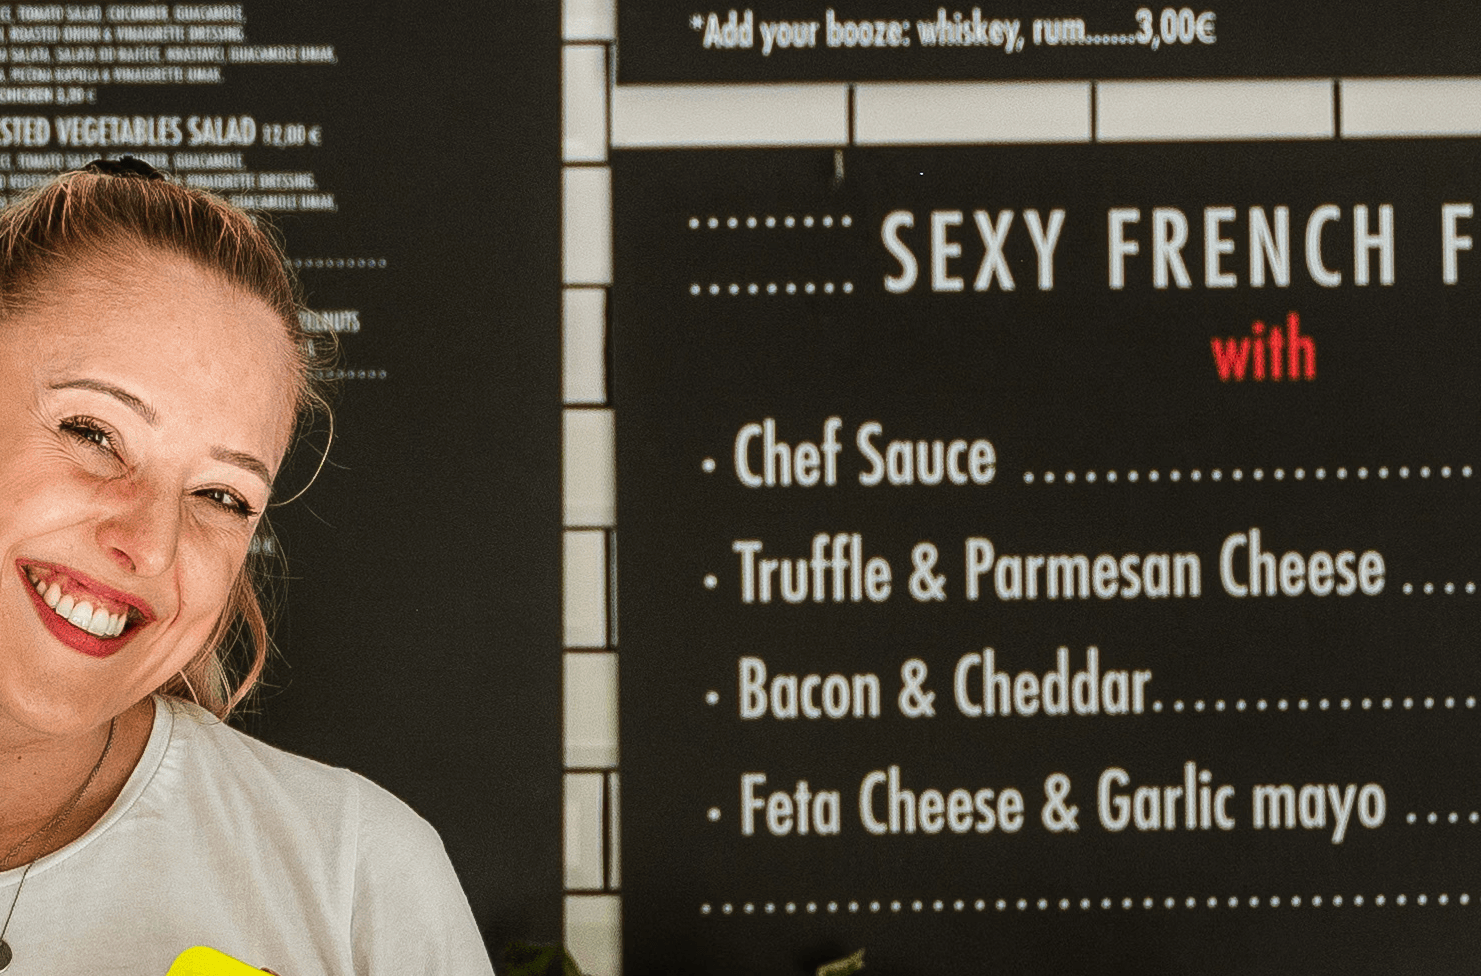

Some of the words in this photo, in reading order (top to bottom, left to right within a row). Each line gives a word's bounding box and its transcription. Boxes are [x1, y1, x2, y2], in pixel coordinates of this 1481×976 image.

[760, 23, 820, 57] your
[827, 10, 911, 48] booze:
[918, 9, 1026, 54] whiskey,
[56, 116, 182, 146] VEGETABLES
[188, 116, 257, 146] SALAD
[882, 210, 1066, 294] SEXY
[1109, 205, 1395, 290] FRENCH
[1212, 313, 1317, 382] with
[735, 418, 843, 488] Chef
[858, 423, 997, 487] Sauce
[734, 534, 893, 604] Truffle
[910, 544, 947, 602] &
[967, 538, 1202, 601] Parmesan
[1221, 529, 1386, 598] Cheese
[740, 658, 881, 720] Bacon
[899, 660, 936, 718] &
[742, 774, 841, 836] Feta
[860, 766, 1025, 835] Cheese
[1043, 774, 1079, 833] &
[1099, 762, 1236, 832] Garlic
[1254, 785, 1387, 844] mayo
